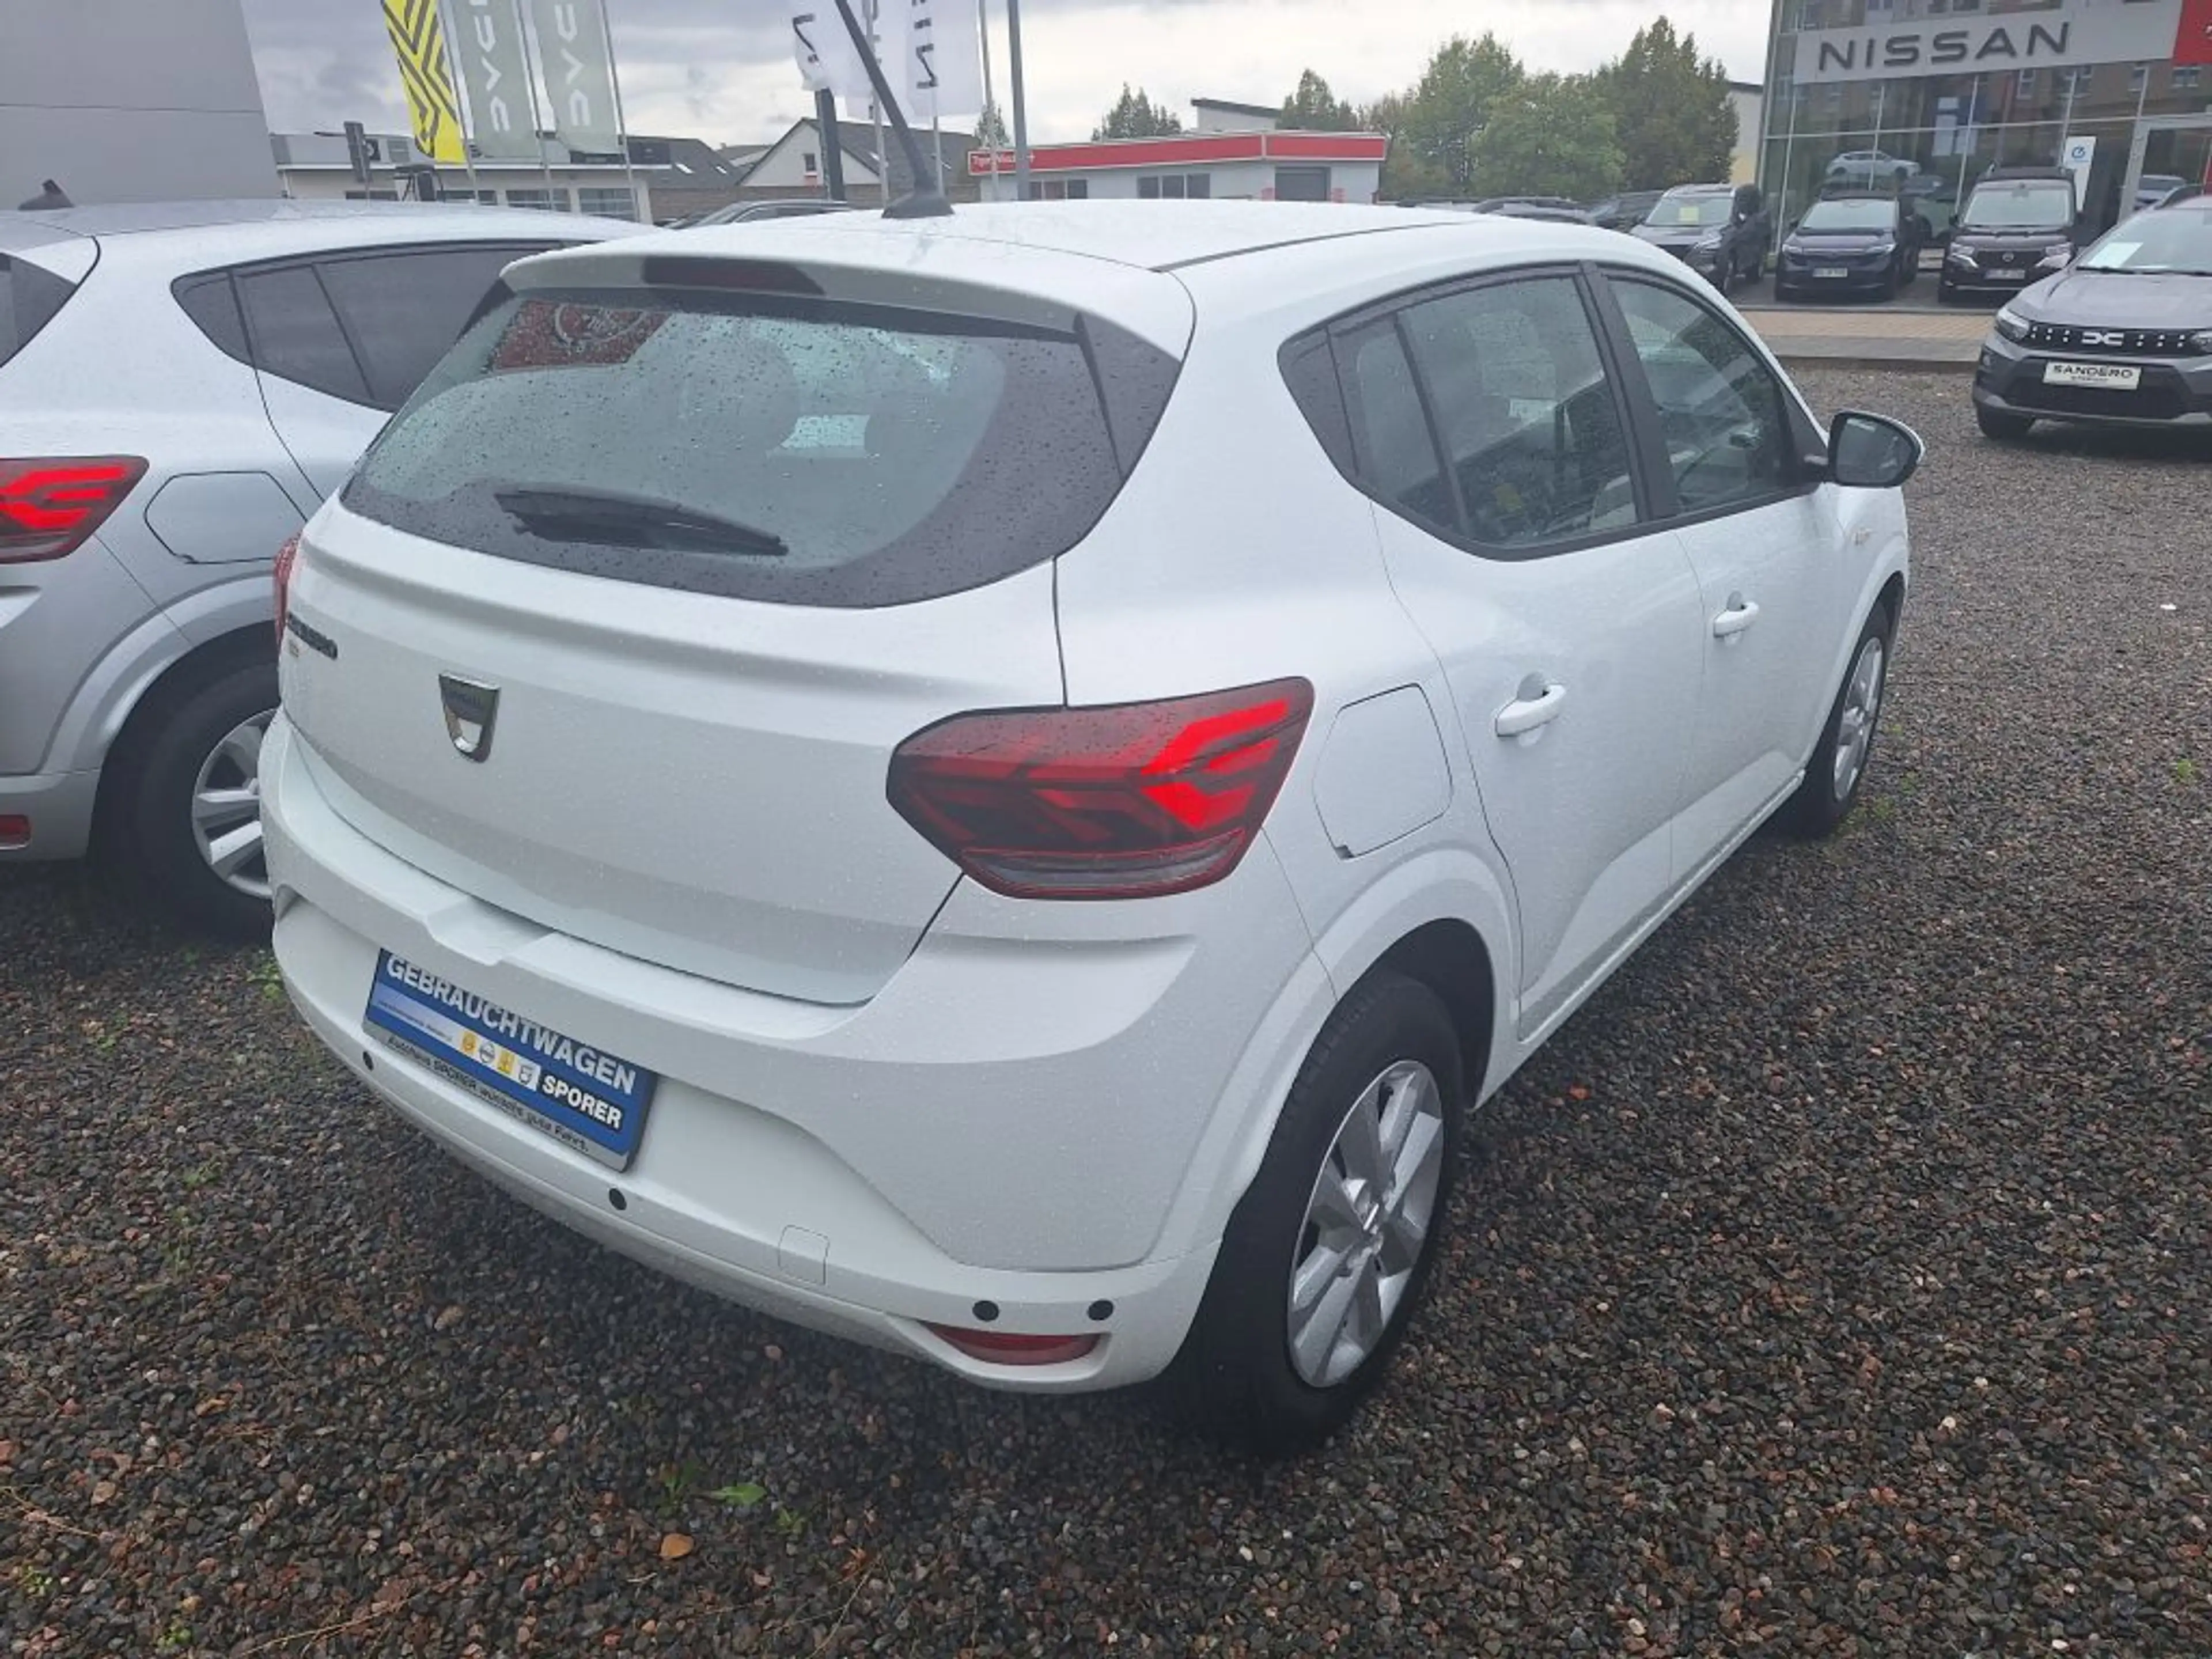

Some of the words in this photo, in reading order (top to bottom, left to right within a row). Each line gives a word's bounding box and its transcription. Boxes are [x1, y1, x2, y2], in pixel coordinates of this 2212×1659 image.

[1819, 21, 2071, 71] NISSAN
[2053, 365, 2133, 379] SANDERO
[387, 955, 636, 1094] GEBRAUCHTWAGEN
[542, 1075, 623, 1128] SPORER
